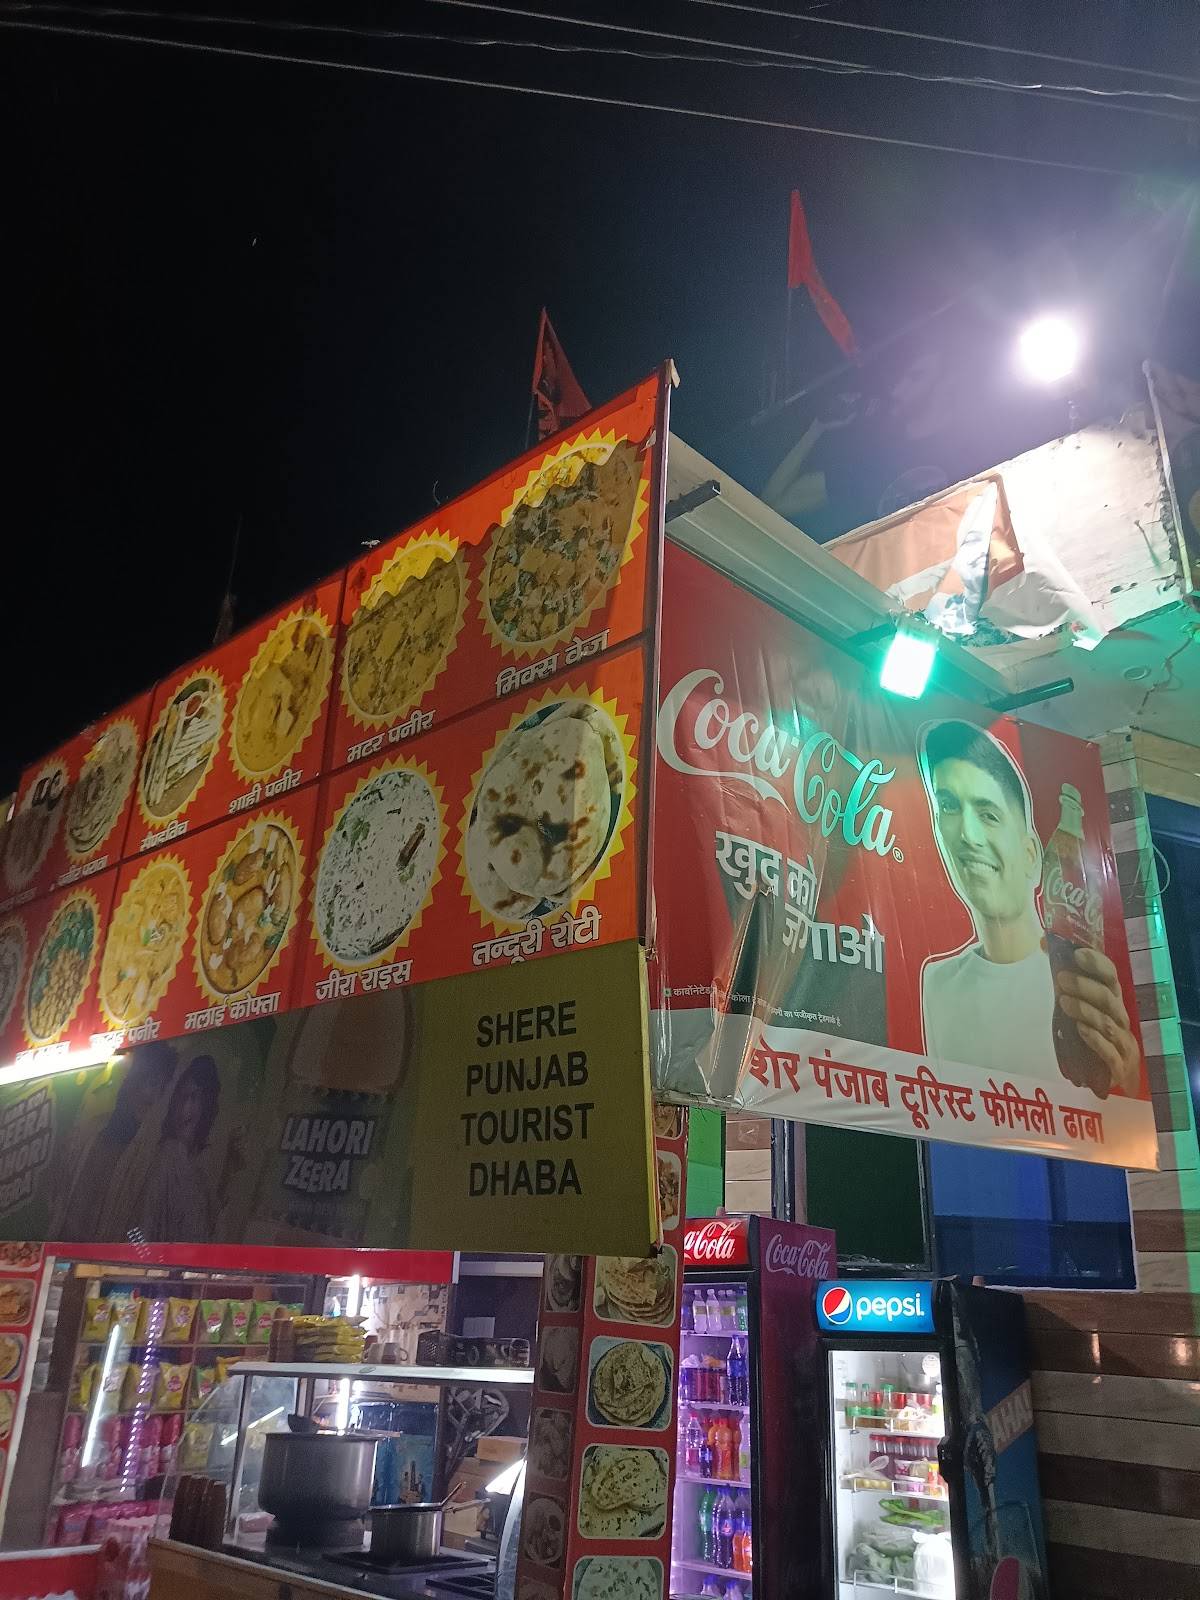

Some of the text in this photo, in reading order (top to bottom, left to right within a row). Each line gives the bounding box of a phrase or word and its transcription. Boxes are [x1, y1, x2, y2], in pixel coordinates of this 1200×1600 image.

[495, 628, 610, 698] मिक्स वेज
[347, 710, 436, 763] मटर पनीर
[656, 669, 897, 857] Coca-Cola
[229, 769, 303, 813] शाही पनीर
[715, 831, 817, 915] खुद को
[550, 905, 602, 948] रोटी
[315, 959, 413, 1000] जीरा राइस
[184, 994, 230, 1030] मलाई
[477, 1001, 577, 1047] SHERE
[466, 1051, 588, 1096] PUNJAB
[750, 1034, 1104, 1144] शेर पंजाब टूरिस्ट फेमिली ढाबा
[281, 1117, 376, 1155] LAHORI
[461, 1103, 594, 1145] TOURIST
[283, 1155, 350, 1193] ZEERA
[469, 1159, 582, 1197] DHABA
[856, 1293, 922, 1321] pepsi
